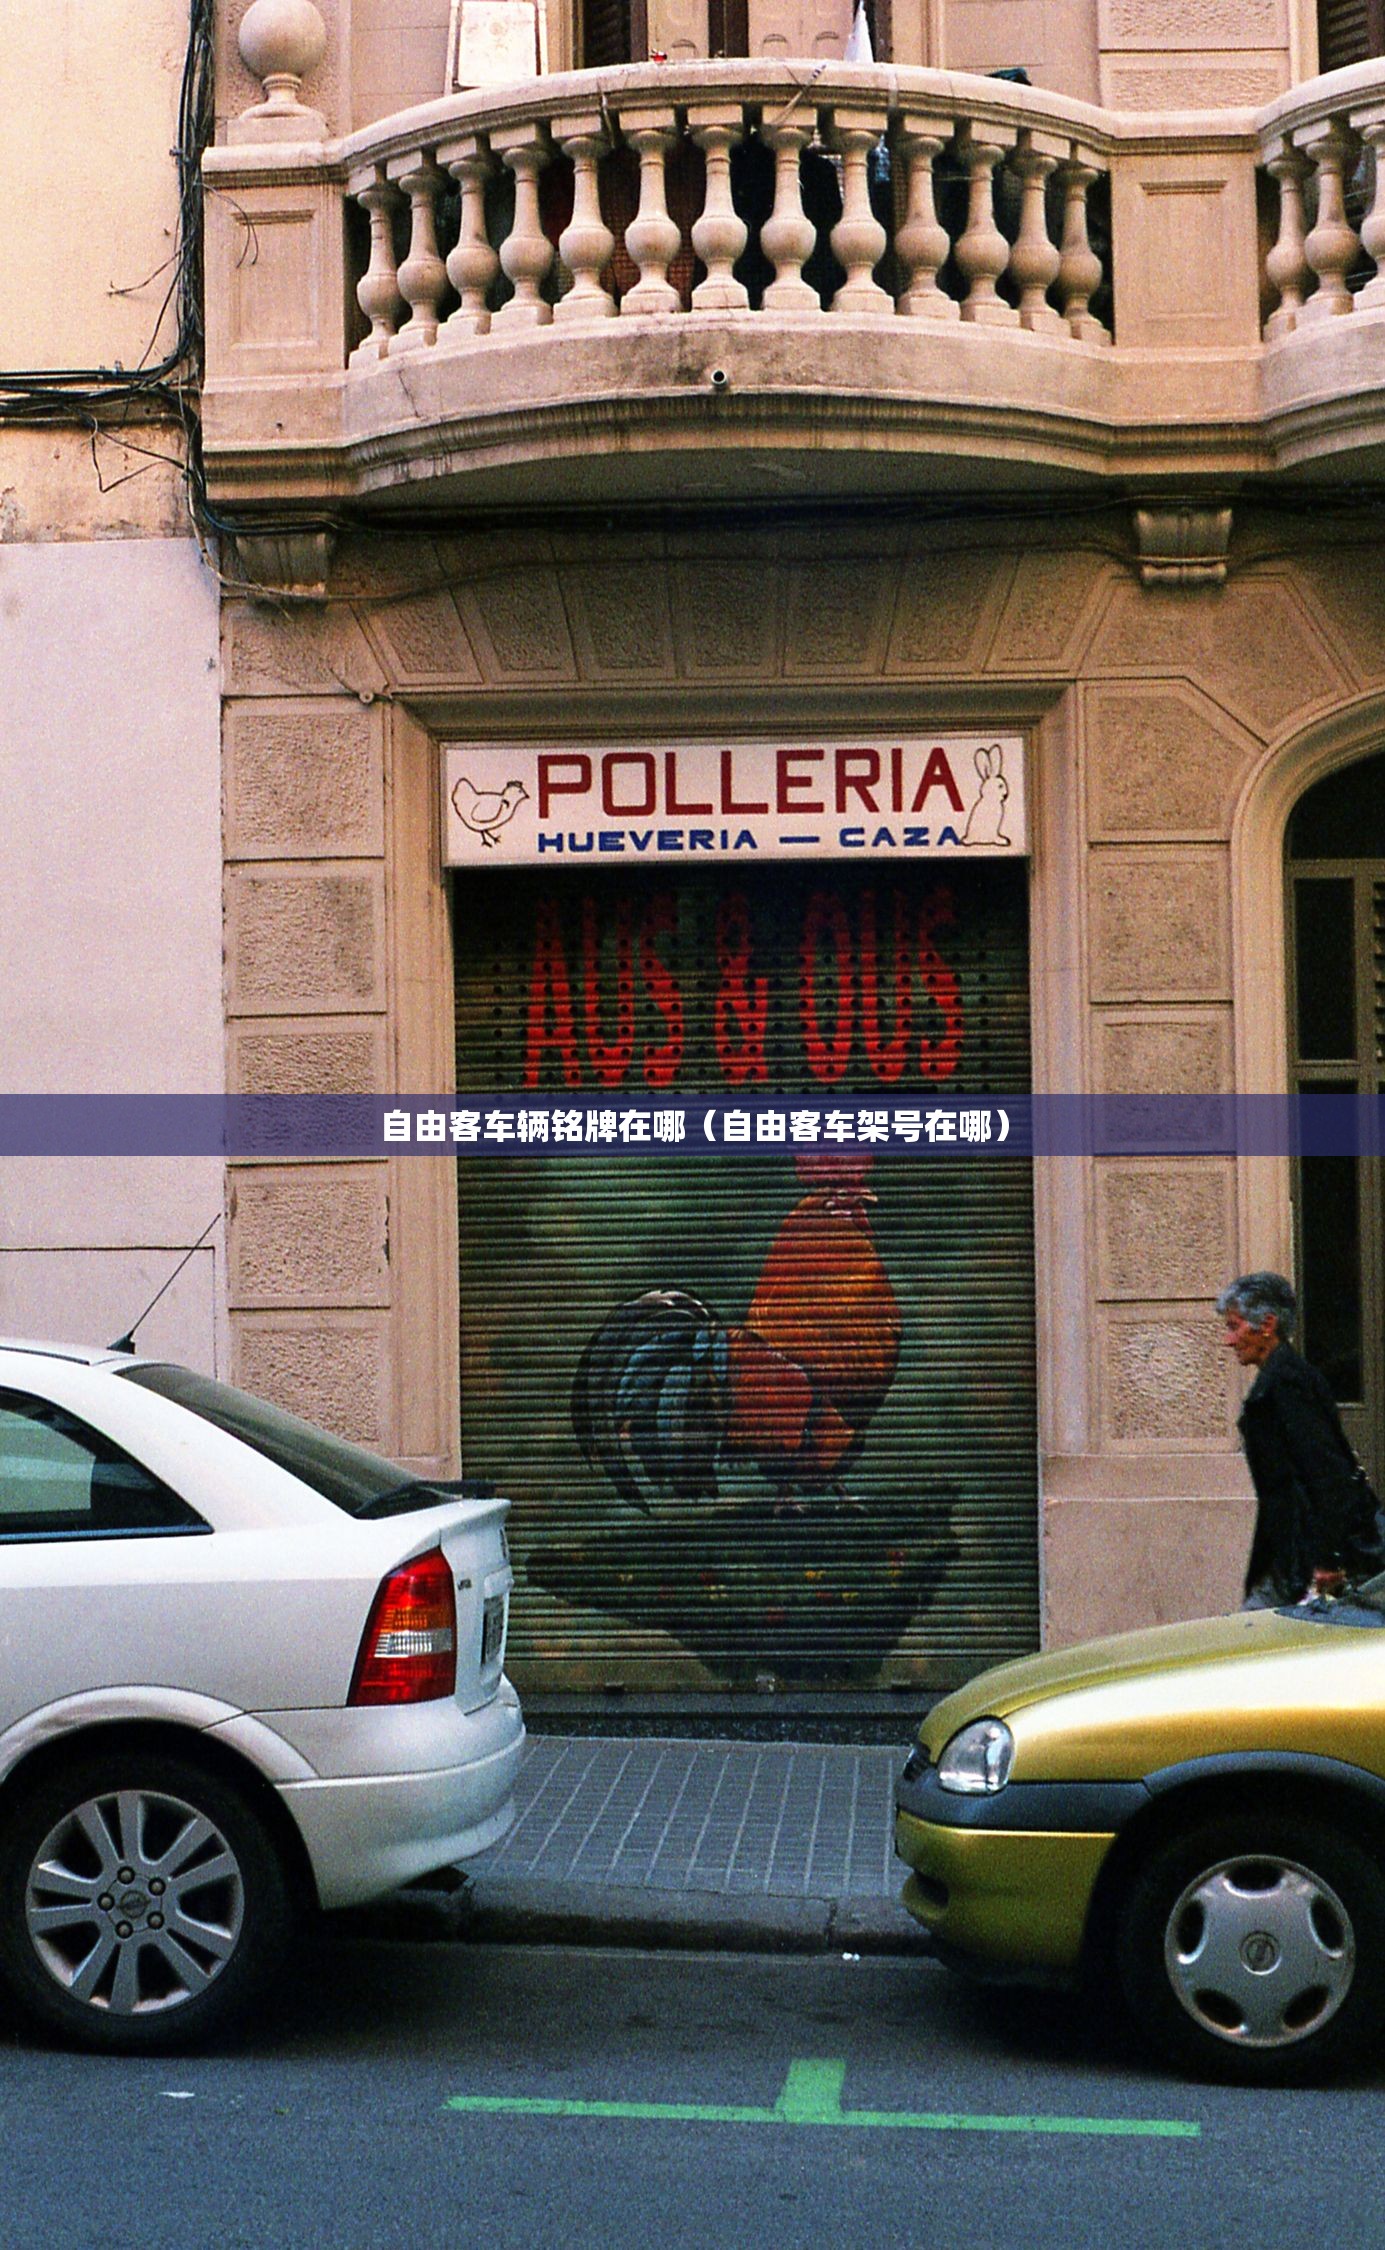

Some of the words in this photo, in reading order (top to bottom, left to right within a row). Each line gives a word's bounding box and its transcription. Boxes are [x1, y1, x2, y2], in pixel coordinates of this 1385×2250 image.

[536, 746, 965, 819] POLLERIA
[537, 828, 758, 854] HUEVERIA
[838, 826, 963, 848] CAZA
[523, 892, 684, 1088] AUS
[713, 890, 769, 1086] &
[799, 884, 965, 1083] OUS
